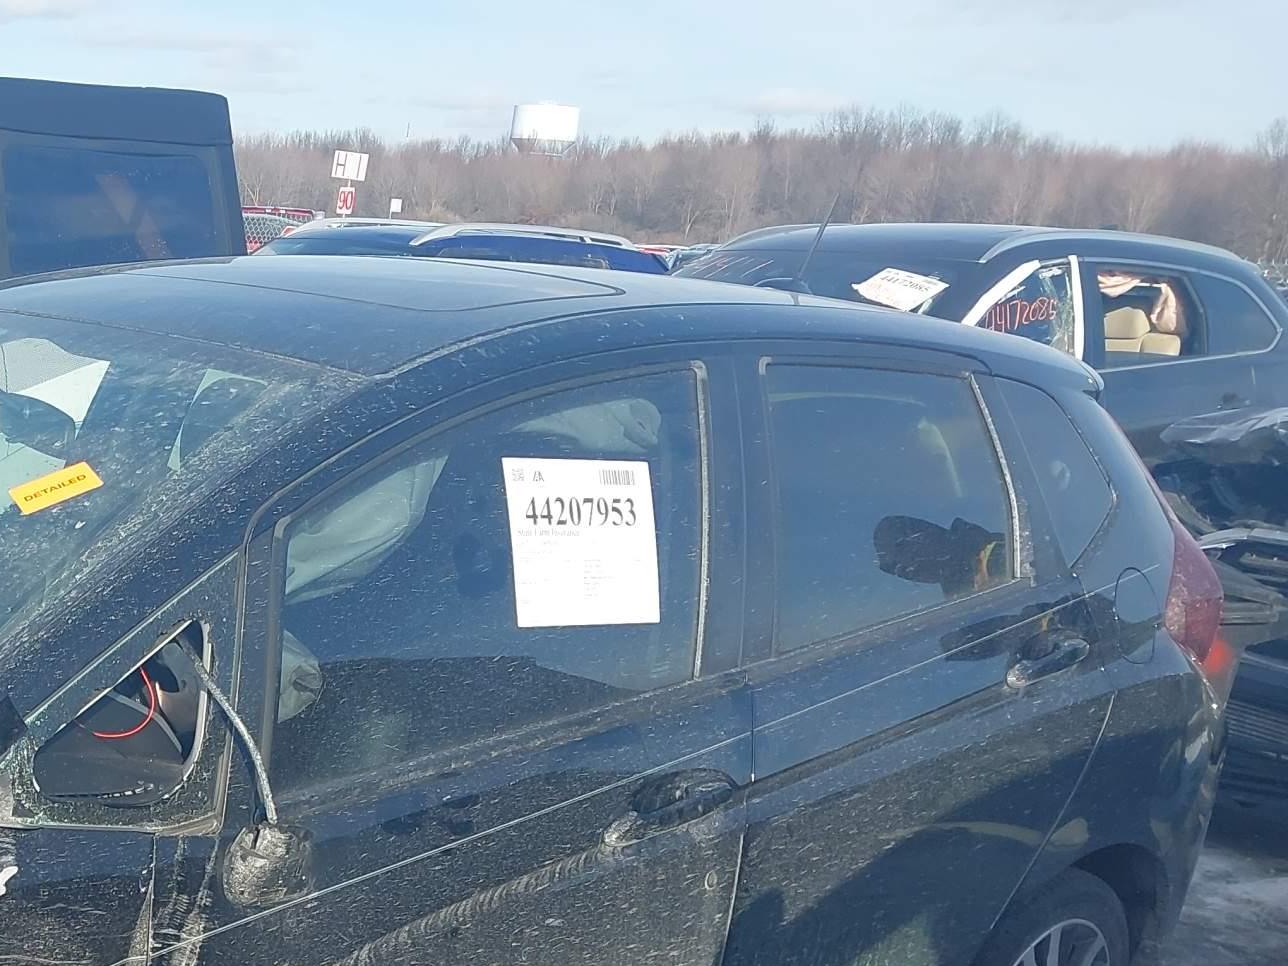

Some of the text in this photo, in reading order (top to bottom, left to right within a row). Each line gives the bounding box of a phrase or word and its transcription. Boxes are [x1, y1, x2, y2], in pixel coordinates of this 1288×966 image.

[338, 191, 353, 210] 90
[24, 474, 87, 502] DETAILED
[525, 496, 637, 527] 44207953
